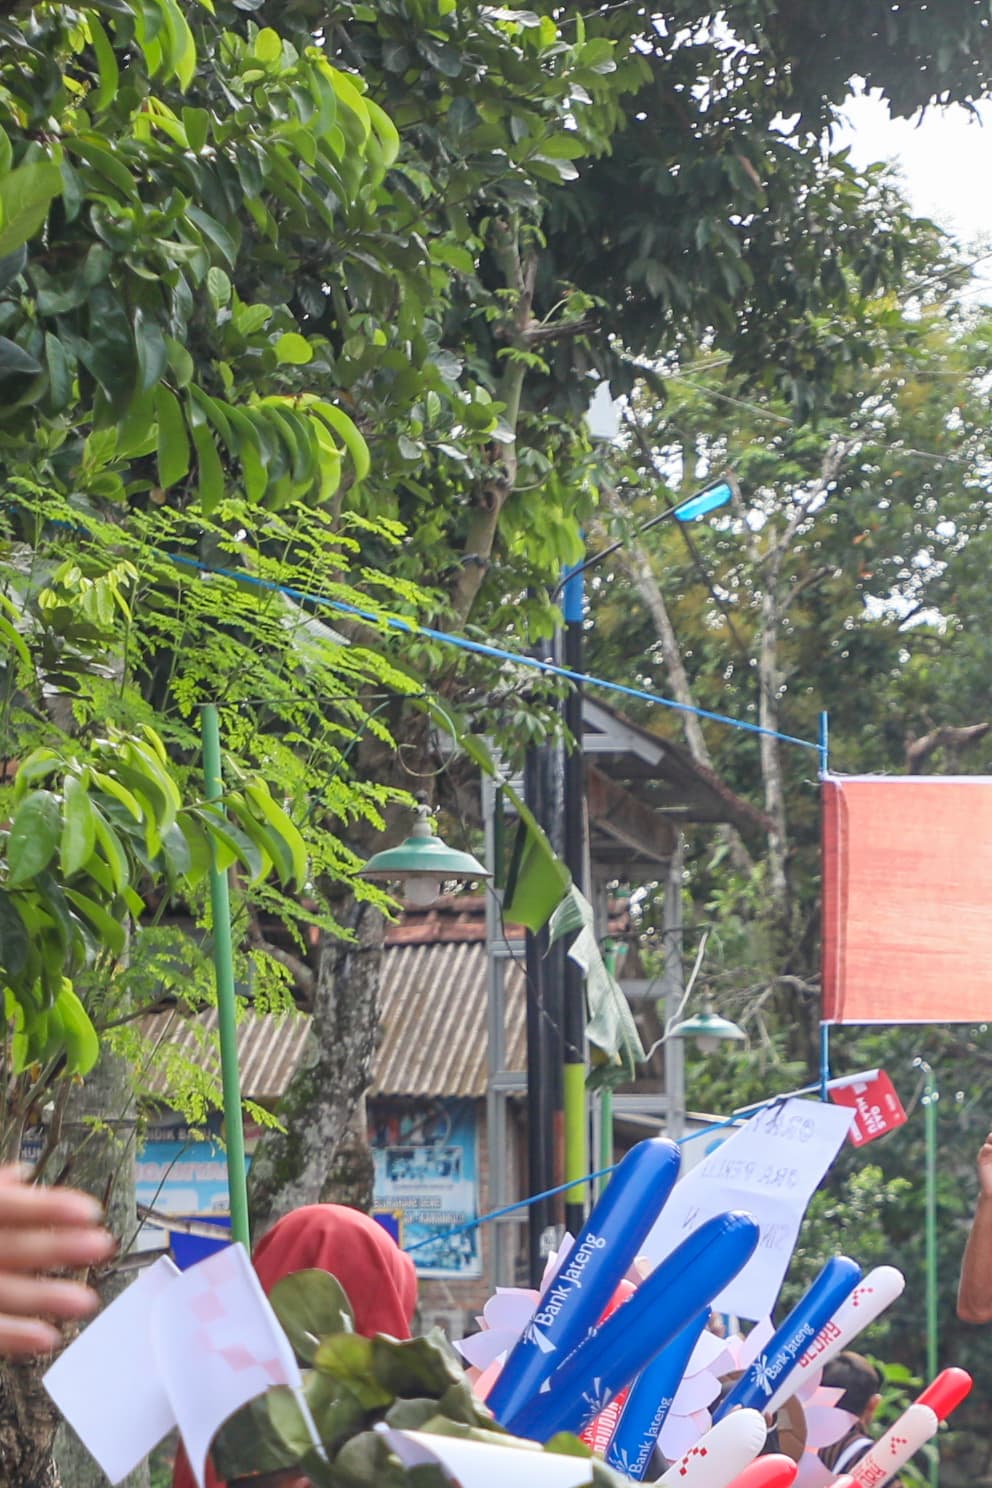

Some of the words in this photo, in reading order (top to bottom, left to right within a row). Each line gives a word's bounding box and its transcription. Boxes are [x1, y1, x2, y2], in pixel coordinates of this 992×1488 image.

[535, 1285, 571, 1326] Bank
[560, 1233, 606, 1288] Jateng
[765, 1352, 790, 1379] Bank
[783, 1322, 815, 1359] Jateng
[629, 1440, 653, 1473] Bank
[643, 1397, 672, 1438] Jateng
